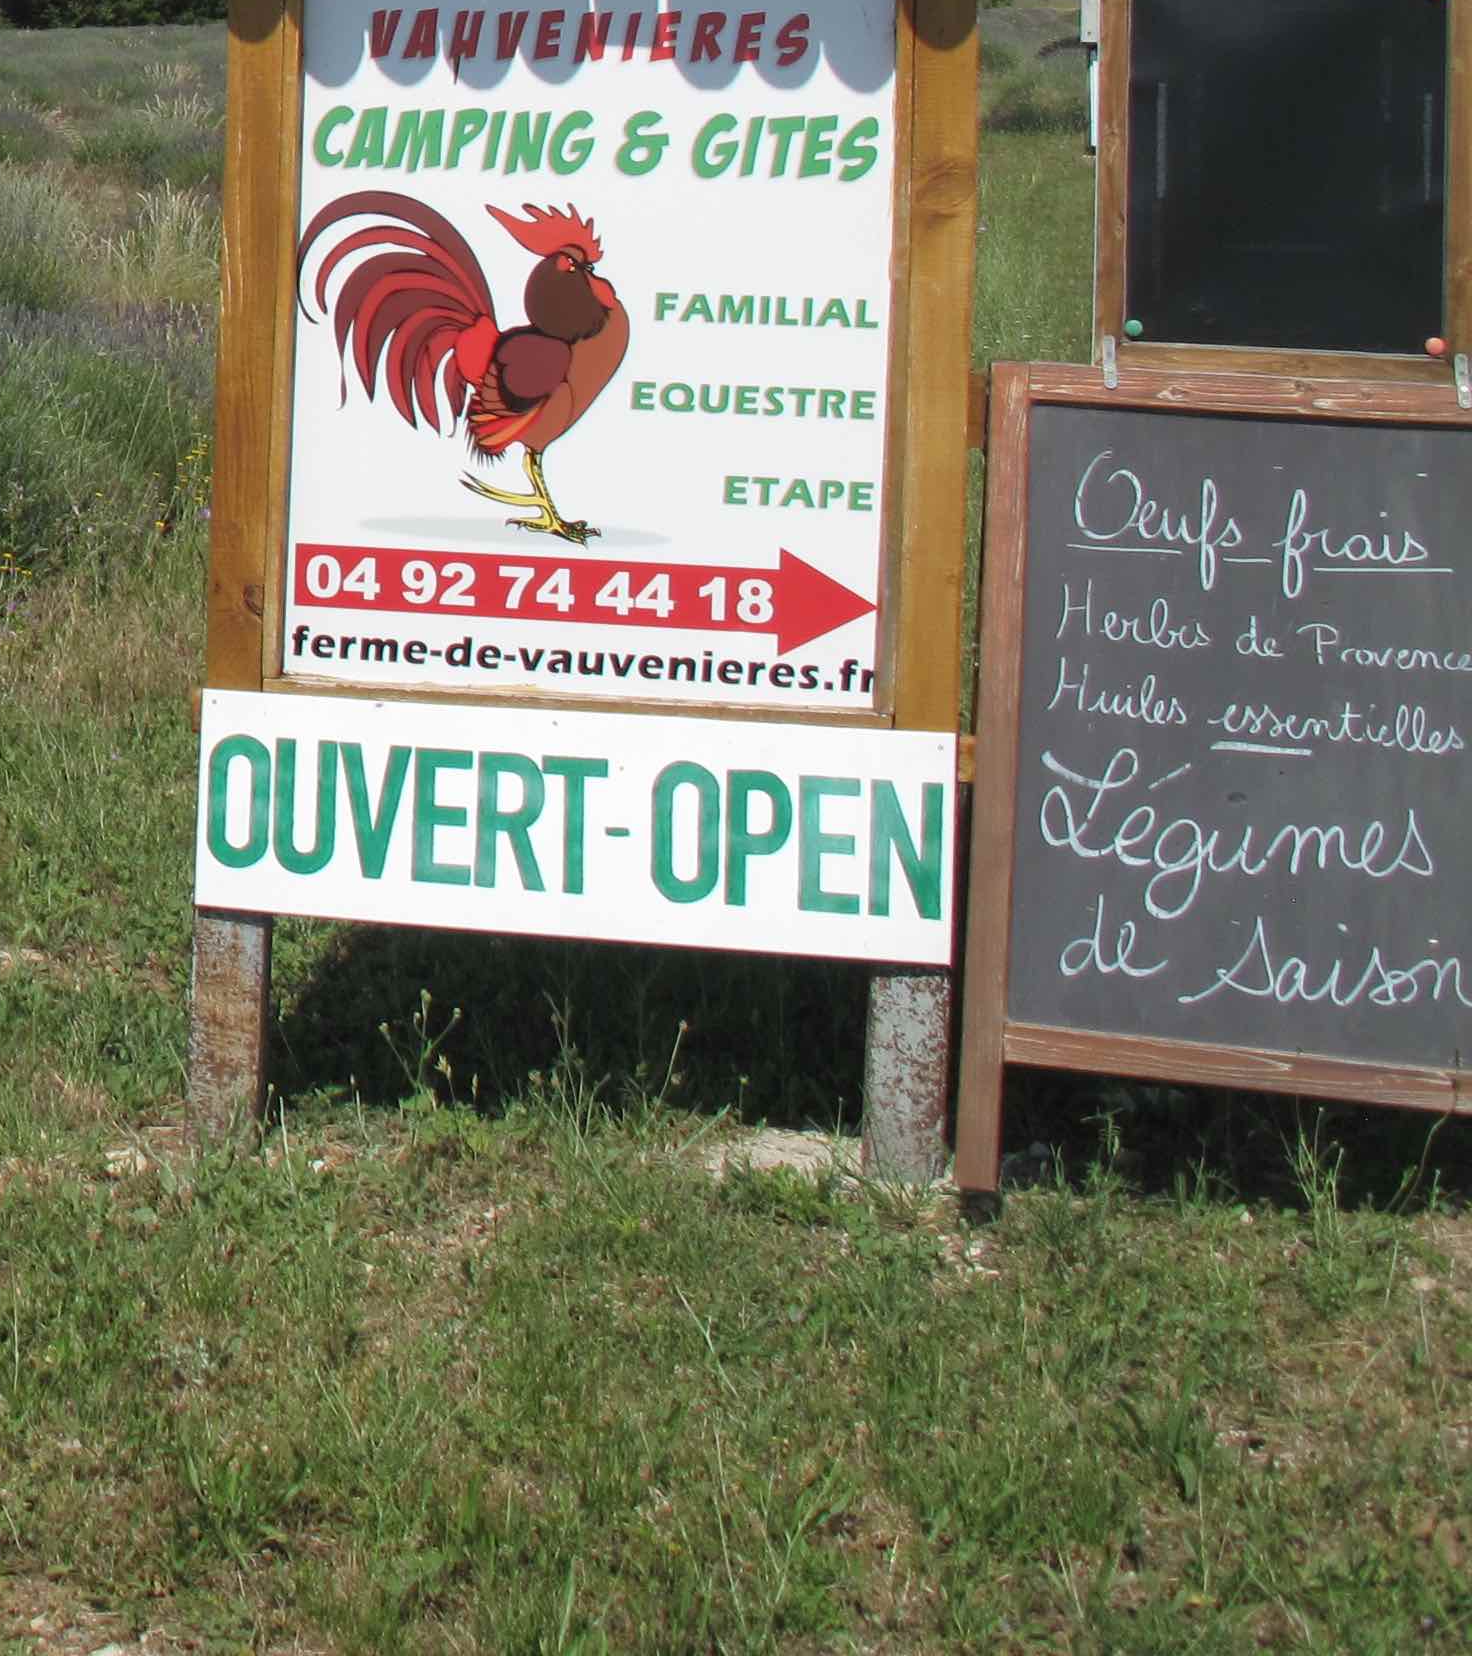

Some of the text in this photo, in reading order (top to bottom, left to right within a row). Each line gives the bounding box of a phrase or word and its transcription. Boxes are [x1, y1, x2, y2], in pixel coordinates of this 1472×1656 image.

[368, 7, 811, 66] VAUVENIERES
[312, 105, 880, 182] CAMPING & GITES
[654, 291, 879, 329] FAMILIAL
[630, 381, 877, 421] EQUESTRE
[722, 476, 875, 512] ETAPE
[1271, 488, 1429, 598] frais
[304, 554, 775, 624] 04 92 74 44 18
[292, 625, 874, 694] ferme-de-vauvenieres.fr
[1235, 615, 1284, 657] de
[1296, 622, 1472, 671] Provence
[1048, 657, 1465, 754] Huiles essentielles
[1040, 748, 1433, 920] Légumes
[1059, 893, 1169, 978] de
